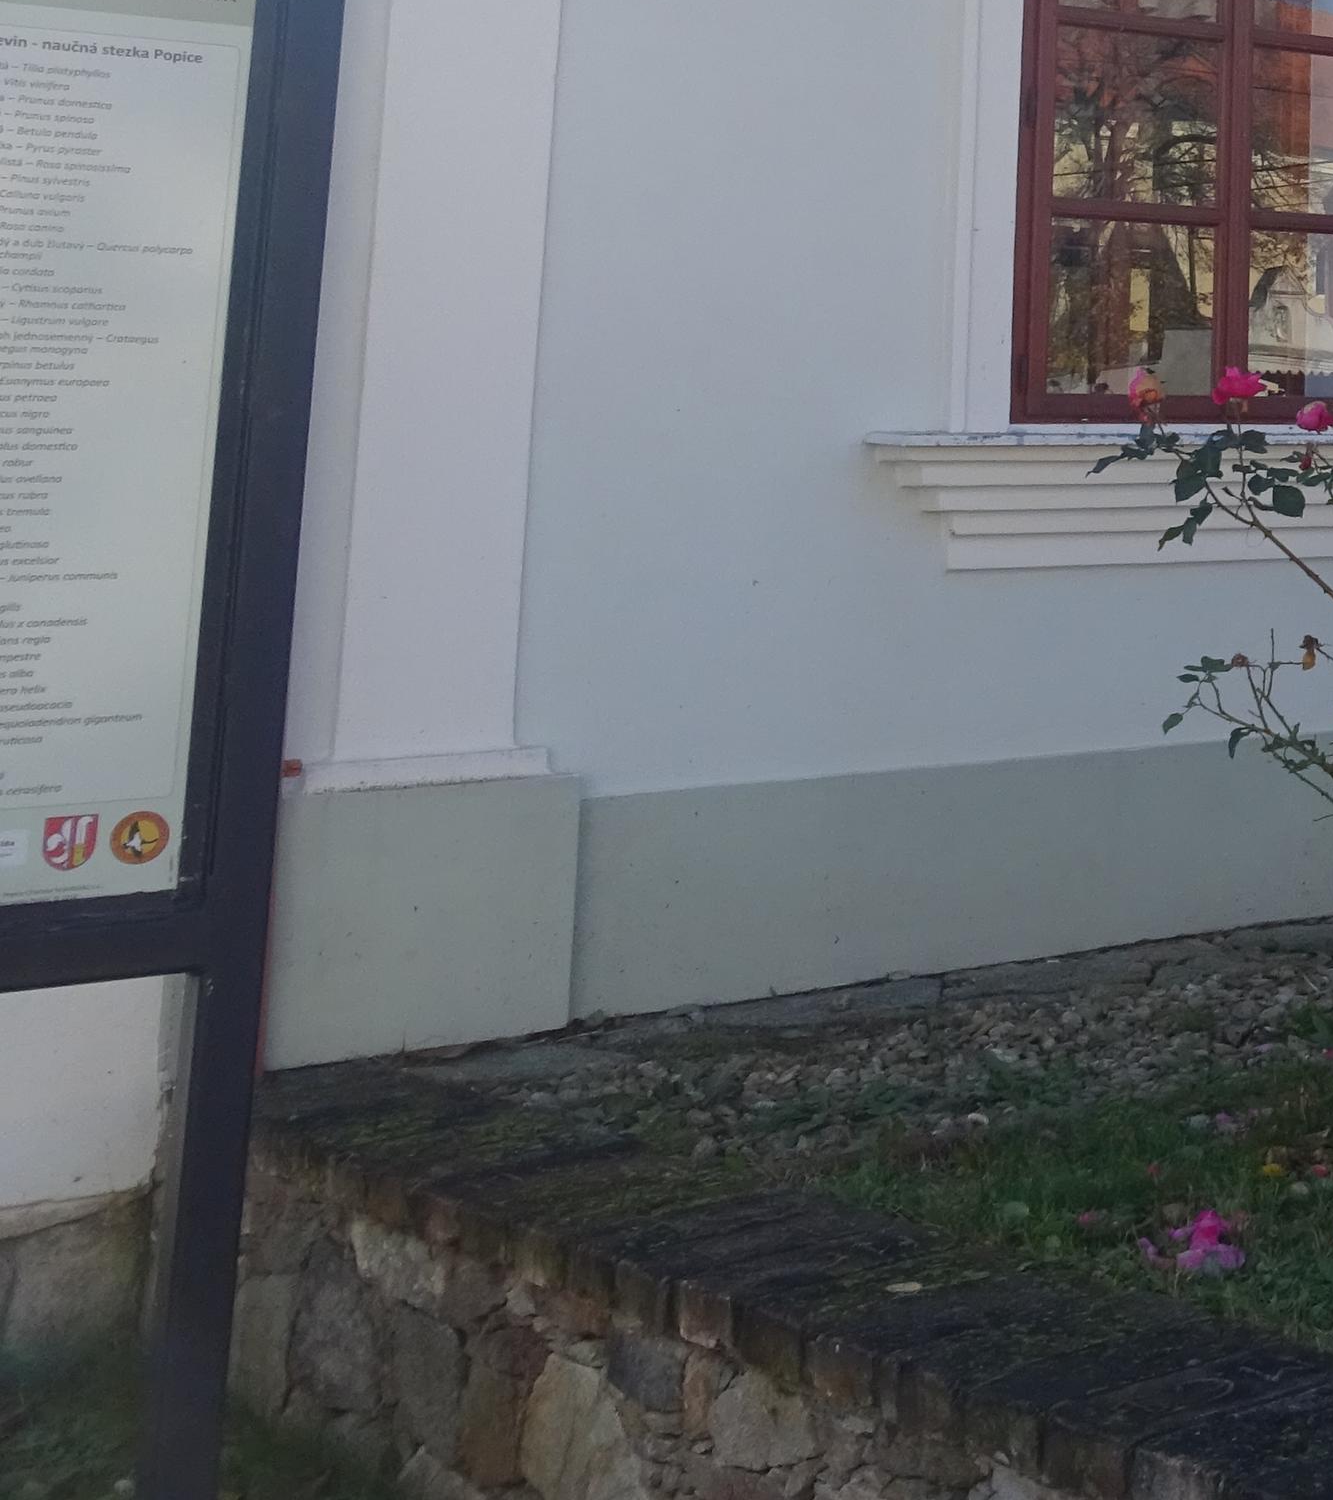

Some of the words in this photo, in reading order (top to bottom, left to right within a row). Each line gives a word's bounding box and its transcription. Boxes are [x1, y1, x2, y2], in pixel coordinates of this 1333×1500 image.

[42, 40, 98, 55] naučná
[102, 45, 149, 59] stezka
[153, 48, 204, 64] Popice
